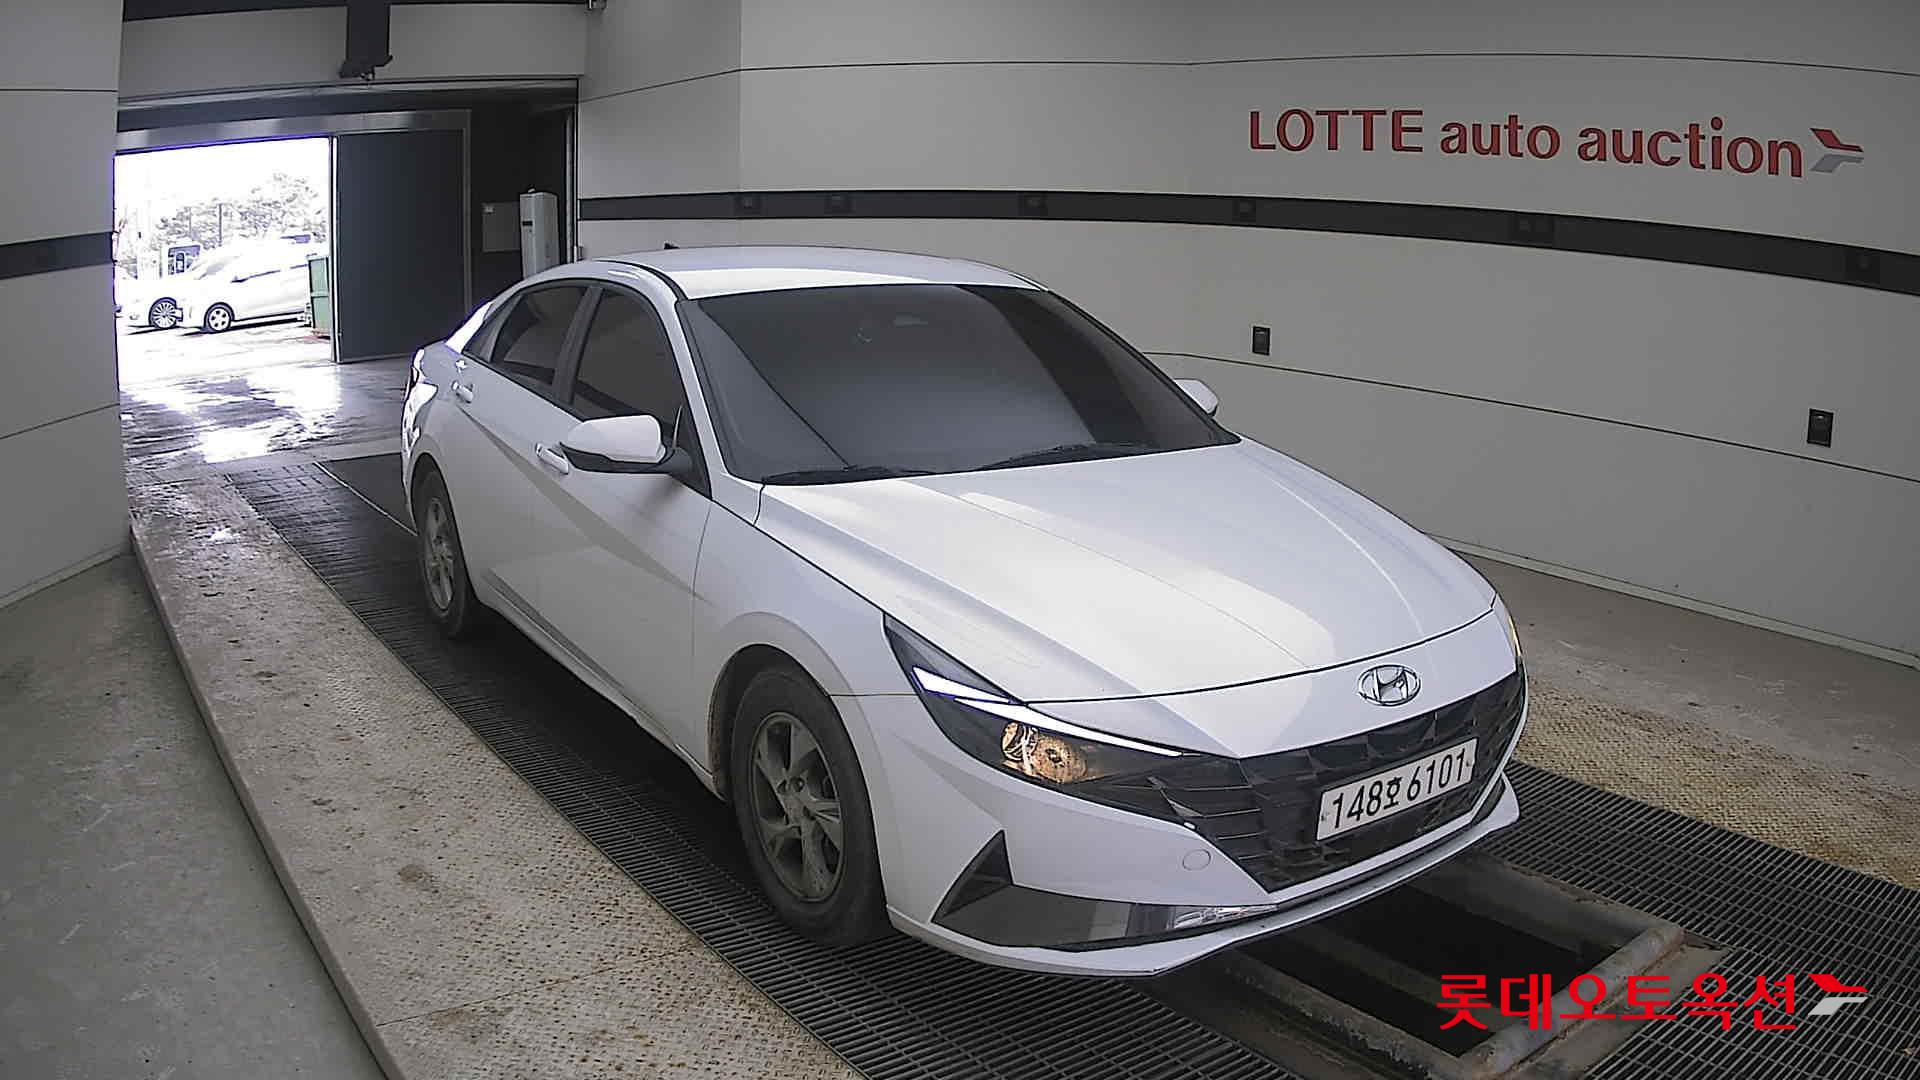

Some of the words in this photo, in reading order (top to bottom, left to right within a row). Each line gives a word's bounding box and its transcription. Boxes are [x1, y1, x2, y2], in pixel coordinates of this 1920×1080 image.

[1249, 109, 1424, 152] LOTTE
[1440, 114, 1561, 159] auto
[1577, 116, 1803, 178] auction
[1333, 777, 1402, 829] 148호
[1407, 748, 1466, 801] 6101
